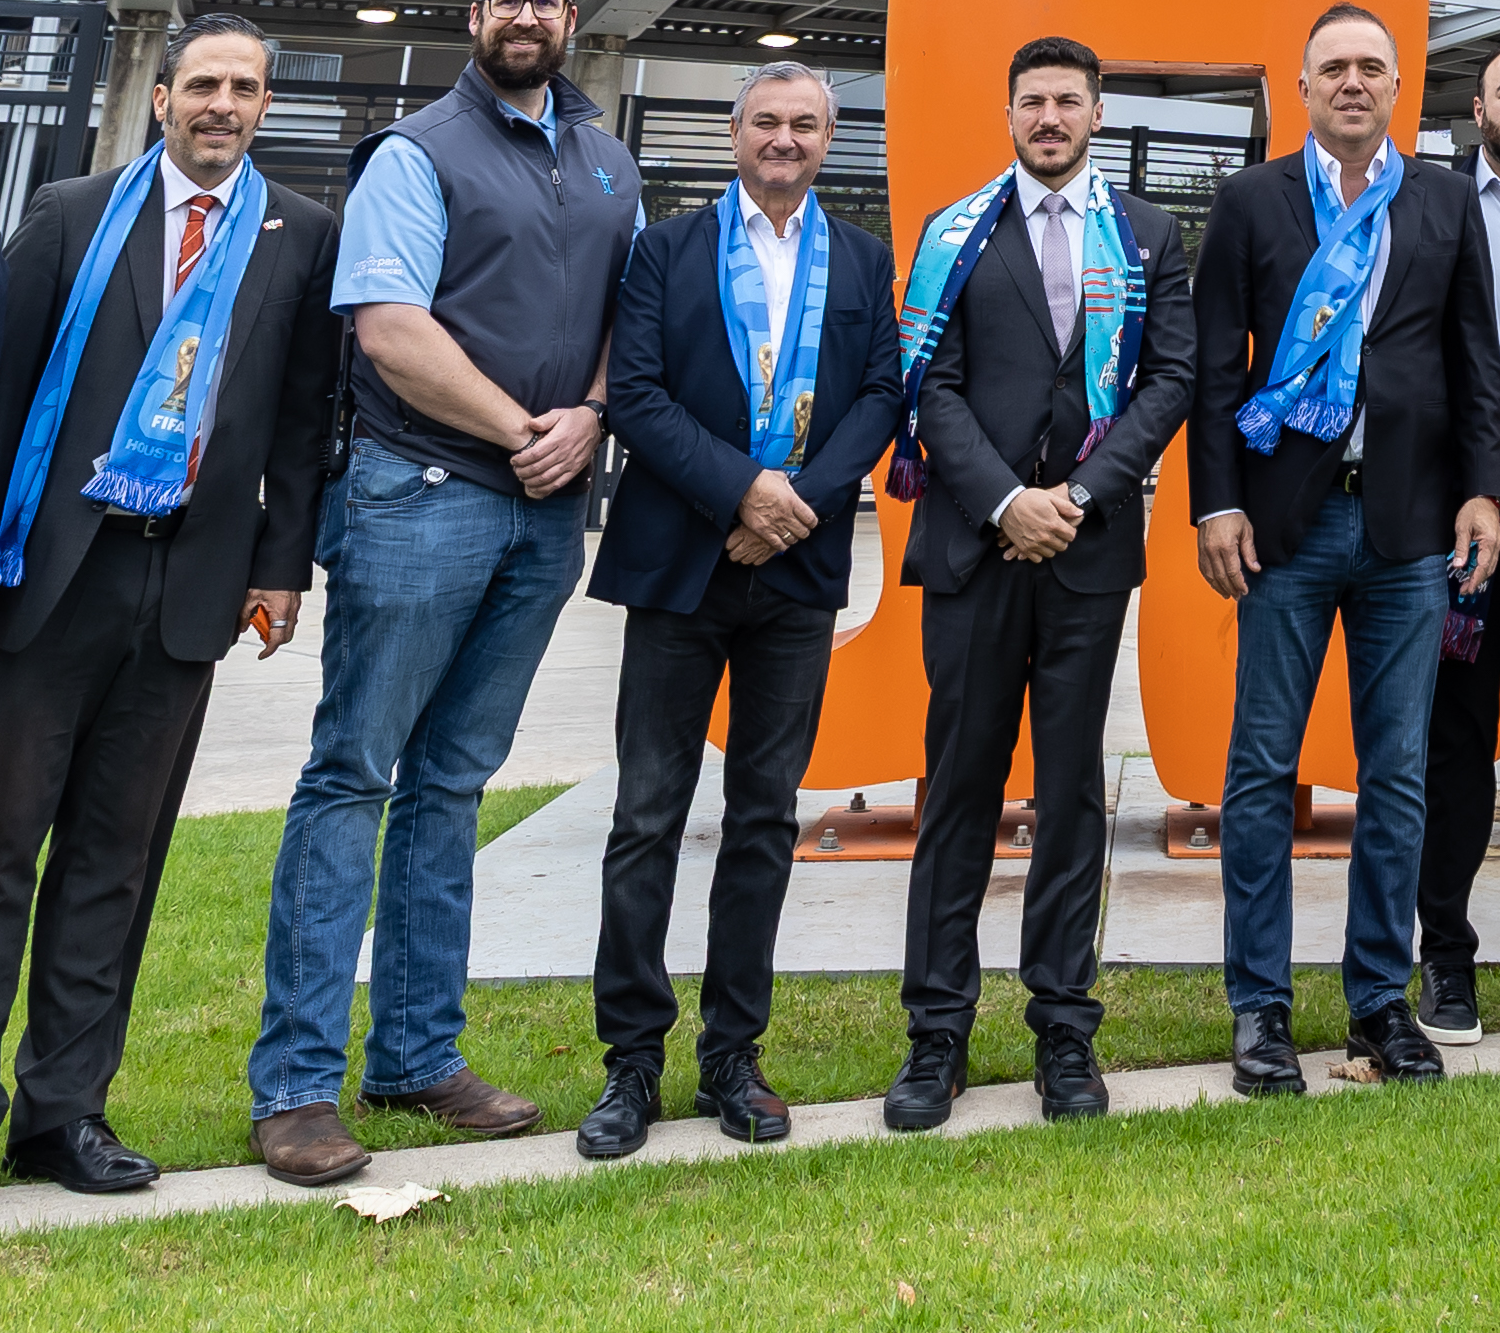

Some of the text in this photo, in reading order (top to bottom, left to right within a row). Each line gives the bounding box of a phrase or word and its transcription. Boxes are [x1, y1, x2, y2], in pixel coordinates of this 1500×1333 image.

[377, 256, 403, 268] park
[151, 414, 185, 435] FIFA
[755, 418, 770, 432] FI
[124, 438, 186, 463] HOUSTO
